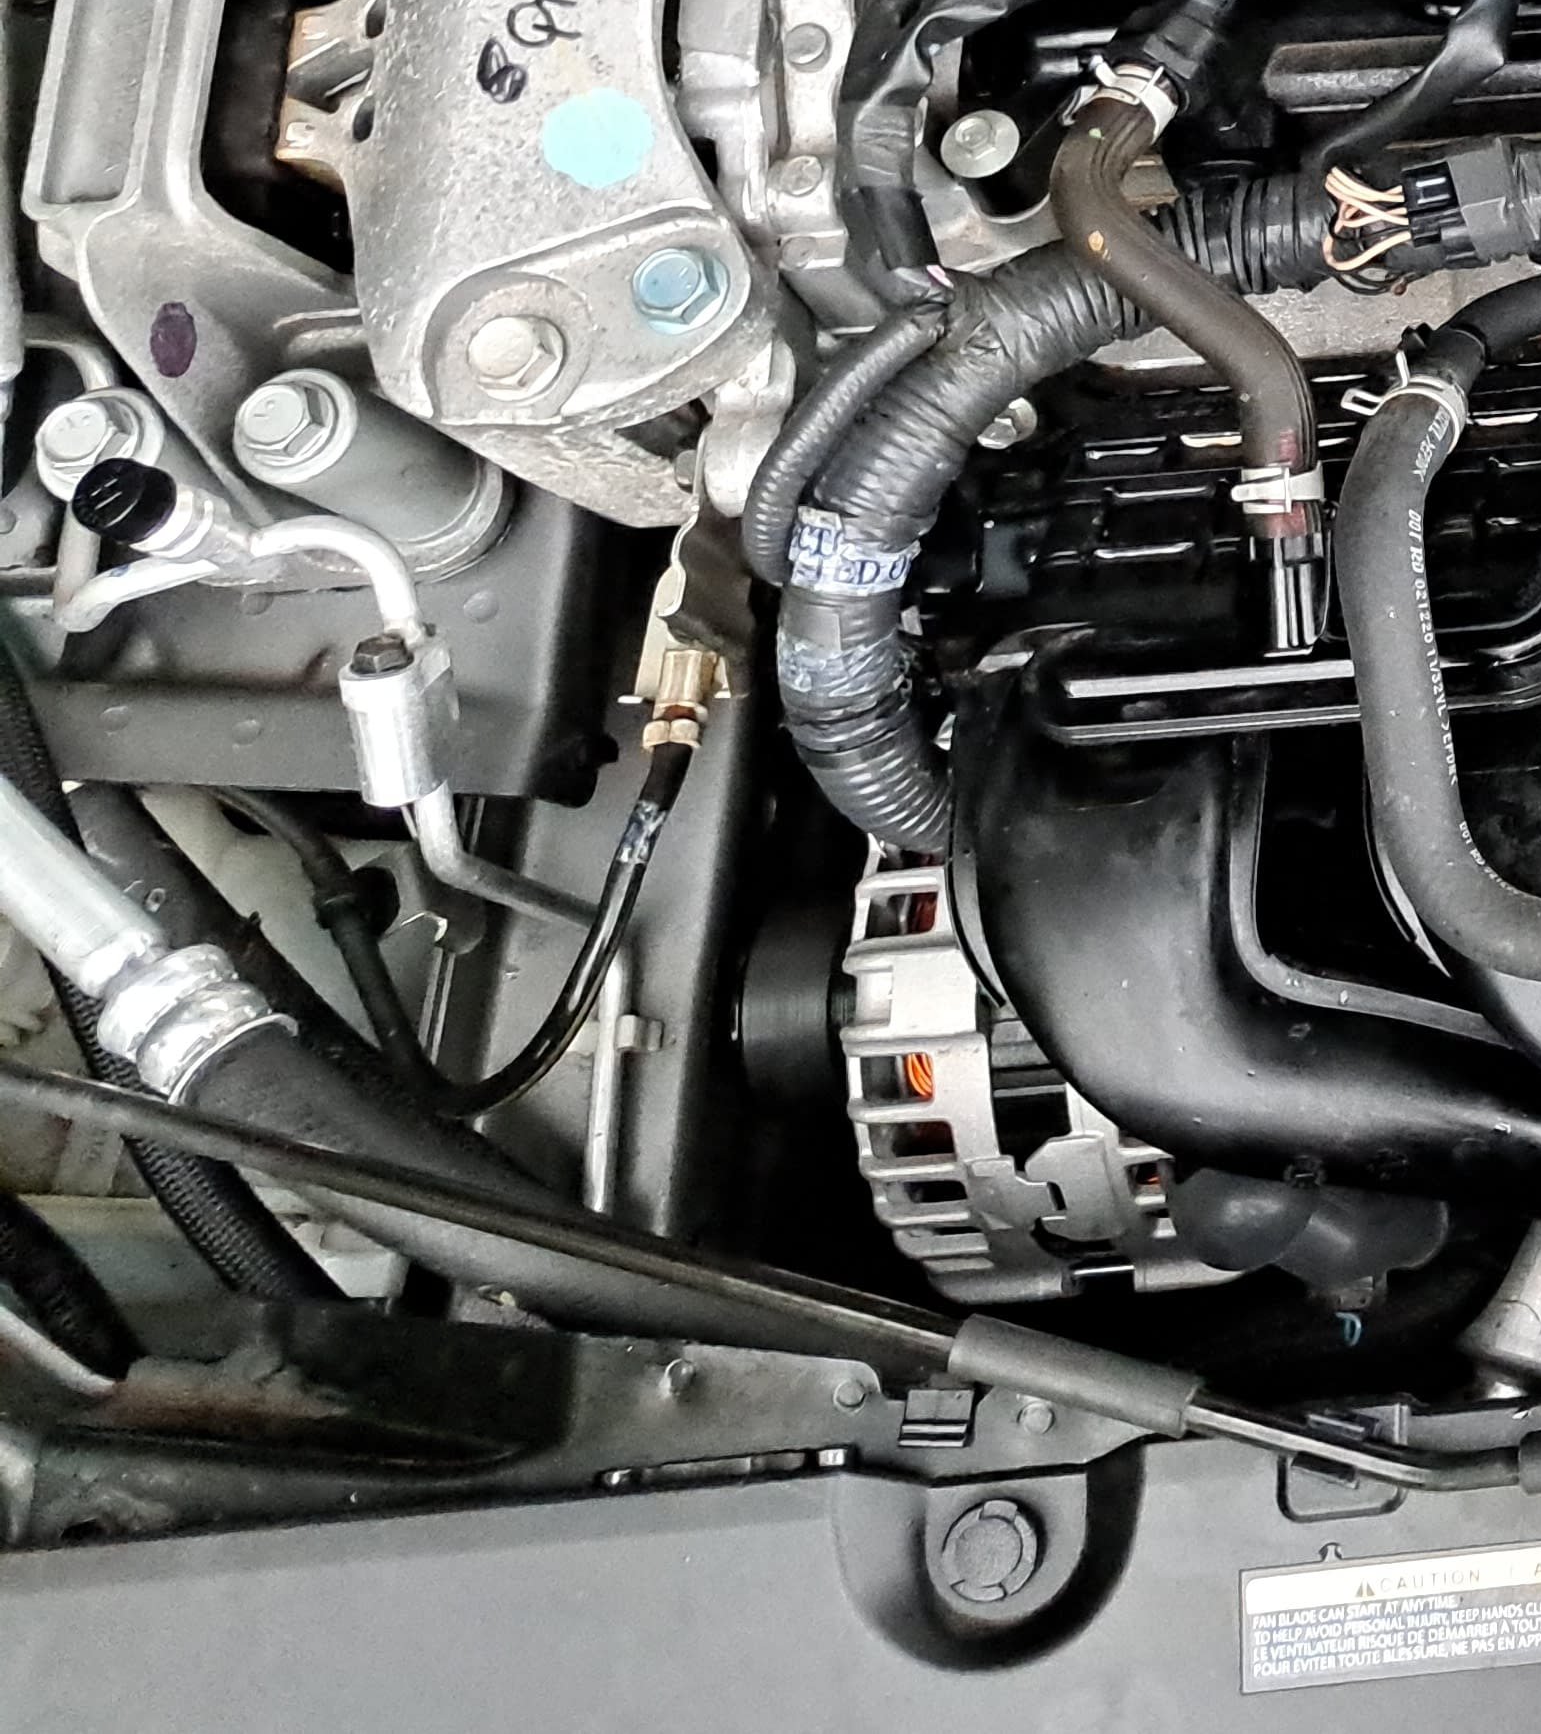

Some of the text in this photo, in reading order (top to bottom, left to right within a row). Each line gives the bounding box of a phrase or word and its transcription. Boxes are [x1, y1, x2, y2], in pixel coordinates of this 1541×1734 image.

[1379, 1569, 1480, 1592] CAUTION
[1252, 1615, 1277, 1629] FAN
[1279, 1610, 1316, 1628] BLADE
[1318, 1606, 1345, 1624] CAN
[1347, 1602, 1382, 1621] START
[1384, 1600, 1399, 1615] AT
[1254, 1631, 1271, 1645] TO
[1272, 1626, 1303, 1643] HELP
[1304, 1623, 1343, 1641] AVOID
[1344, 1617, 1406, 1636] PERSONAL
[1451, 1609, 1481, 1623] KEEP
[1482, 1605, 1524, 1620] HANDS
[1253, 1647, 1268, 1662] LE
[1270, 1638, 1356, 1659] VENTILATEUR
[1358, 1633, 1406, 1650] RISQUE
[1408, 1630, 1425, 1644] DE
[1253, 1658, 1291, 1677] POUR
[1337, 1649, 1381, 1667] TOUTE
[1451, 1639, 1468, 1655] NE
[1471, 1636, 1495, 1653] PAS
[1497, 1635, 1516, 1650] EN
